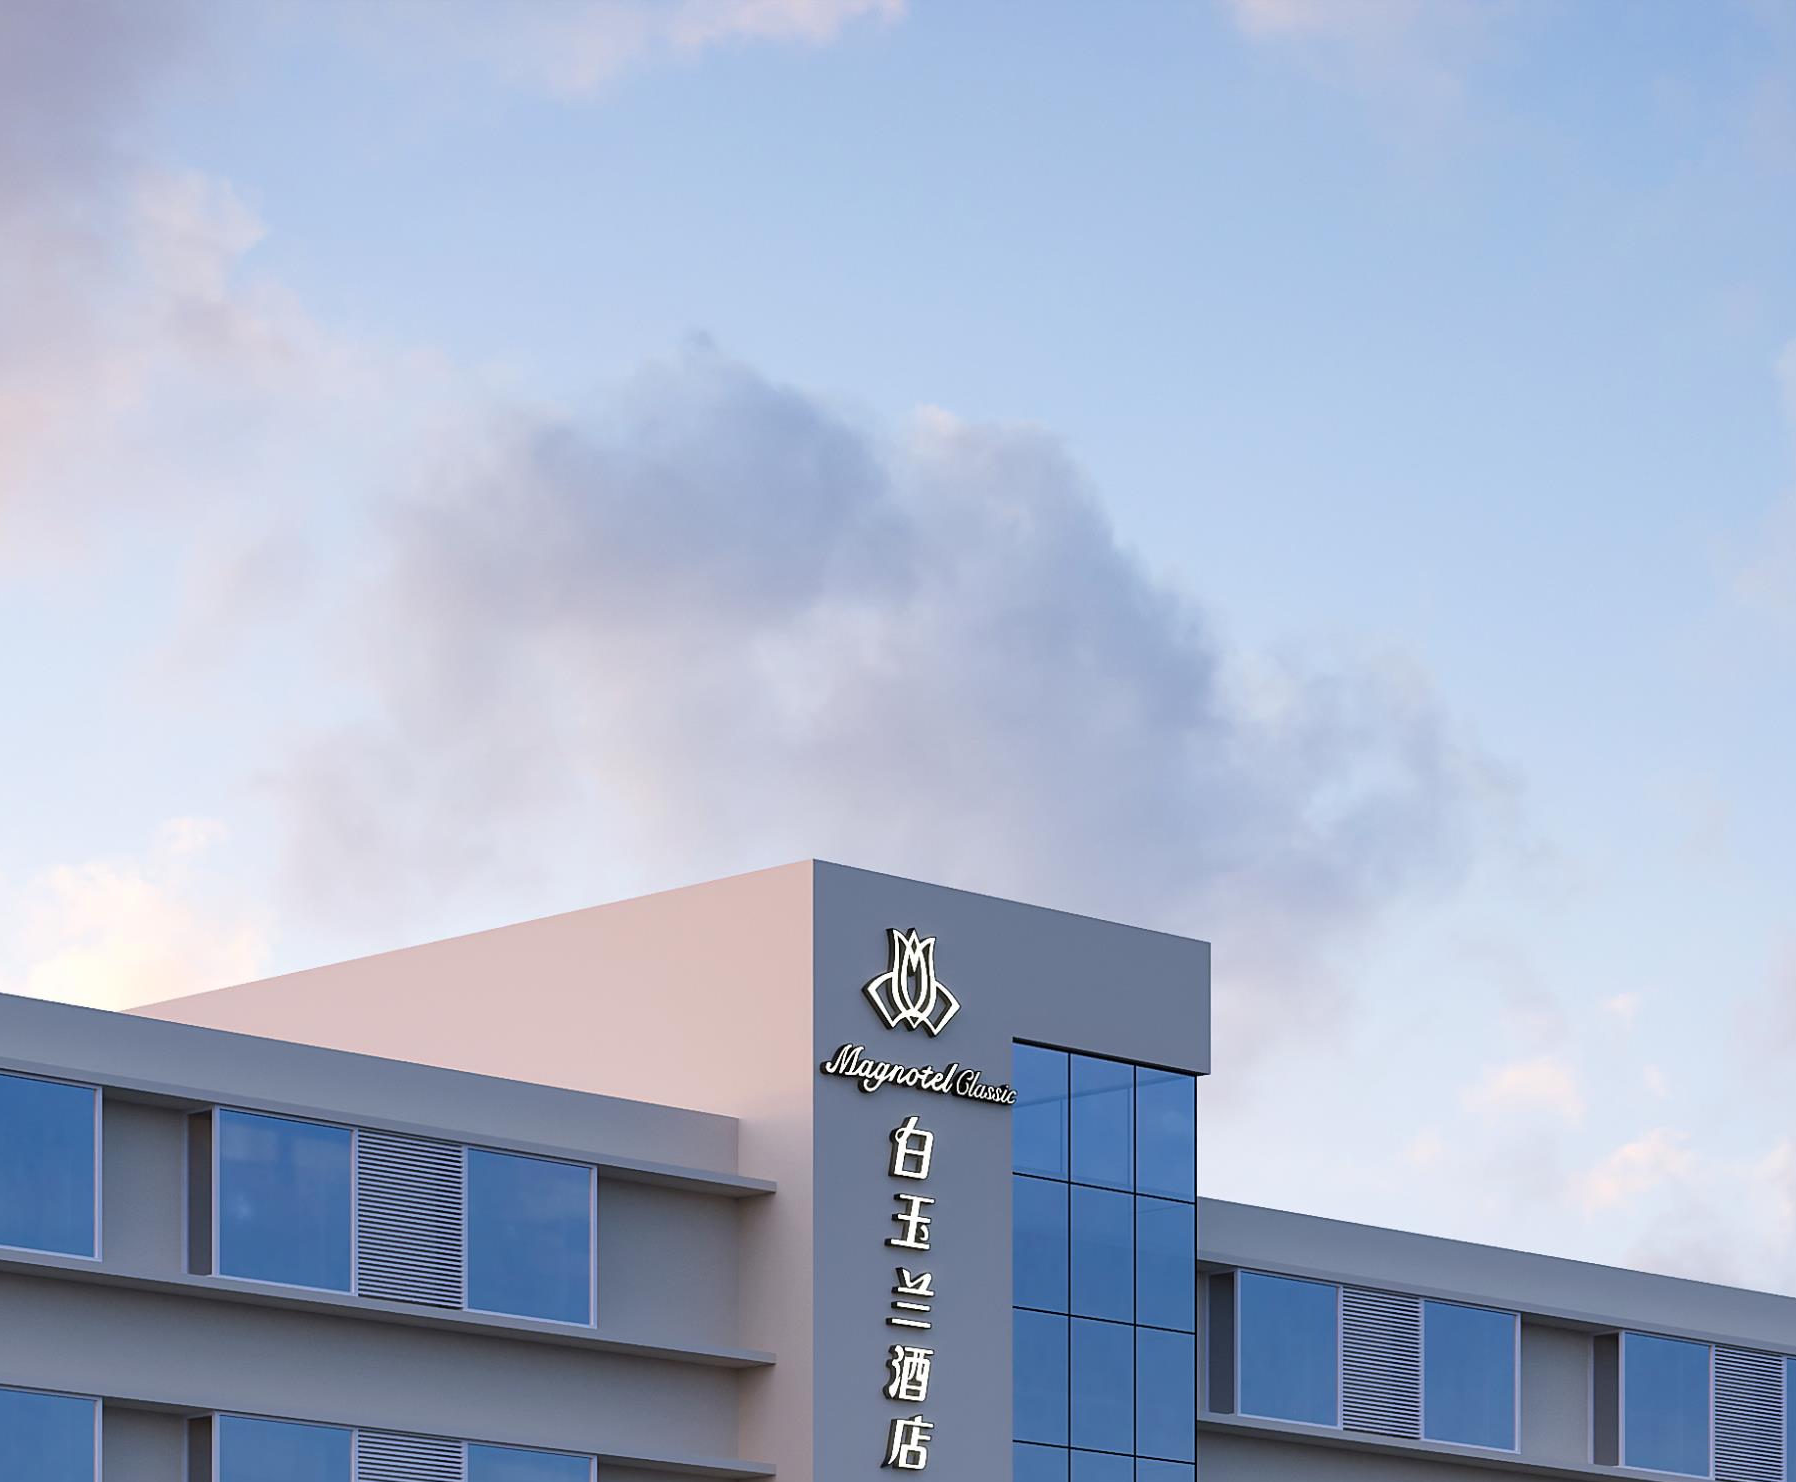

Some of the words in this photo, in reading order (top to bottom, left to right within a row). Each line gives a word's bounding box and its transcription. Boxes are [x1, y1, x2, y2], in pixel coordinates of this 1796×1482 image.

[820, 1043, 960, 1094] Magnotel
[953, 1069, 1017, 1106] Classic
[883, 1115, 935, 1470] 白玉兰酒店
